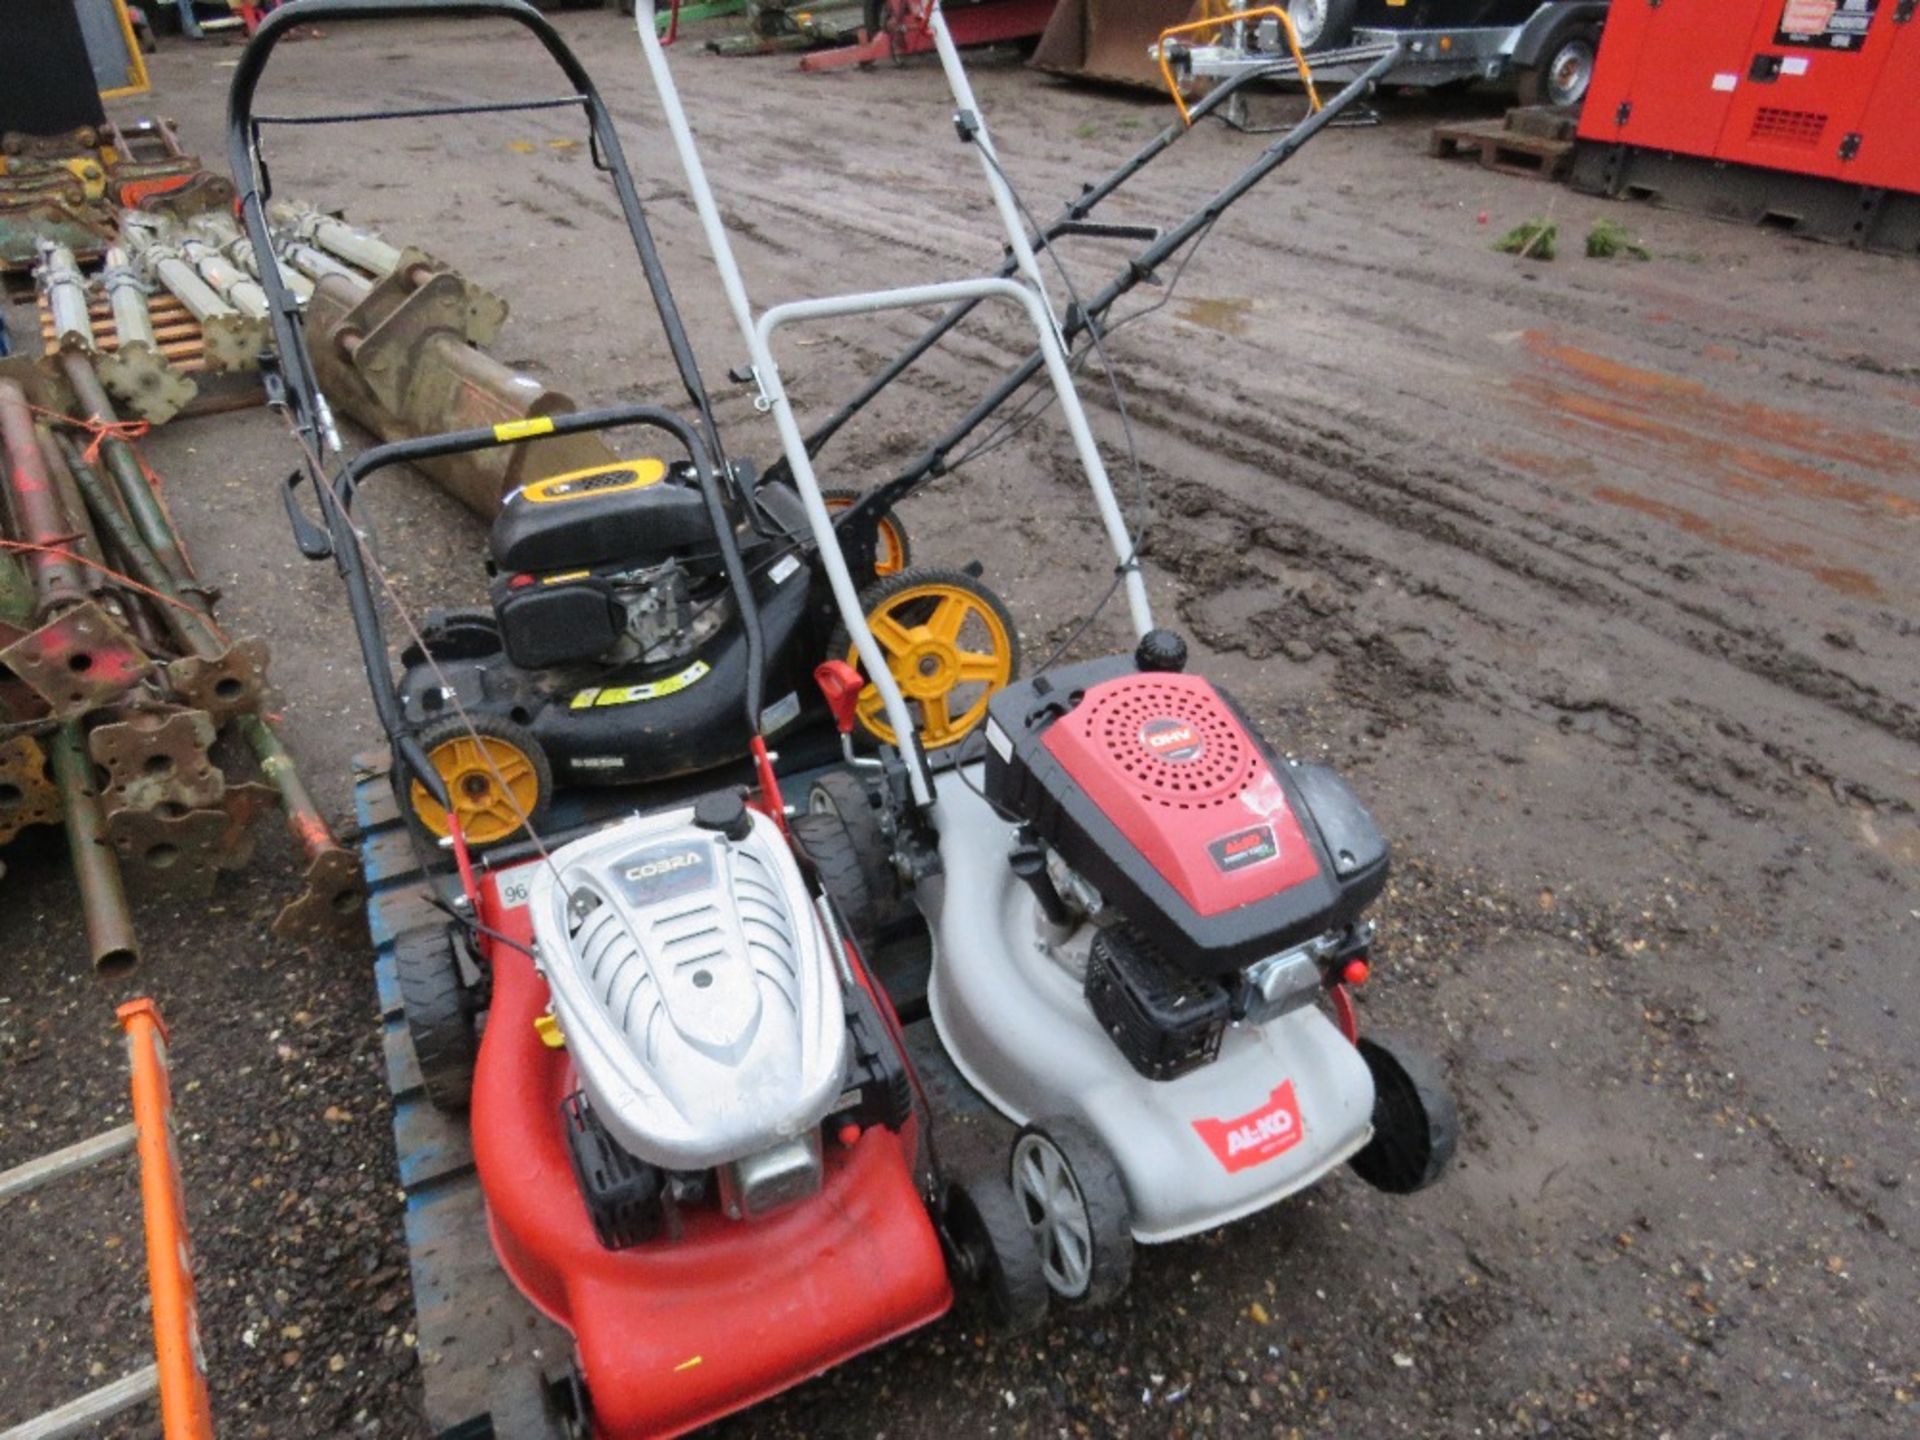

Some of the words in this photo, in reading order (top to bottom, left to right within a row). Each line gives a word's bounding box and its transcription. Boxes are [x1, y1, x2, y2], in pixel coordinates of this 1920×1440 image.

[1149, 729, 1190, 747] OHV
[625, 852, 702, 880] COBRA
[504, 883, 528, 904] 96
